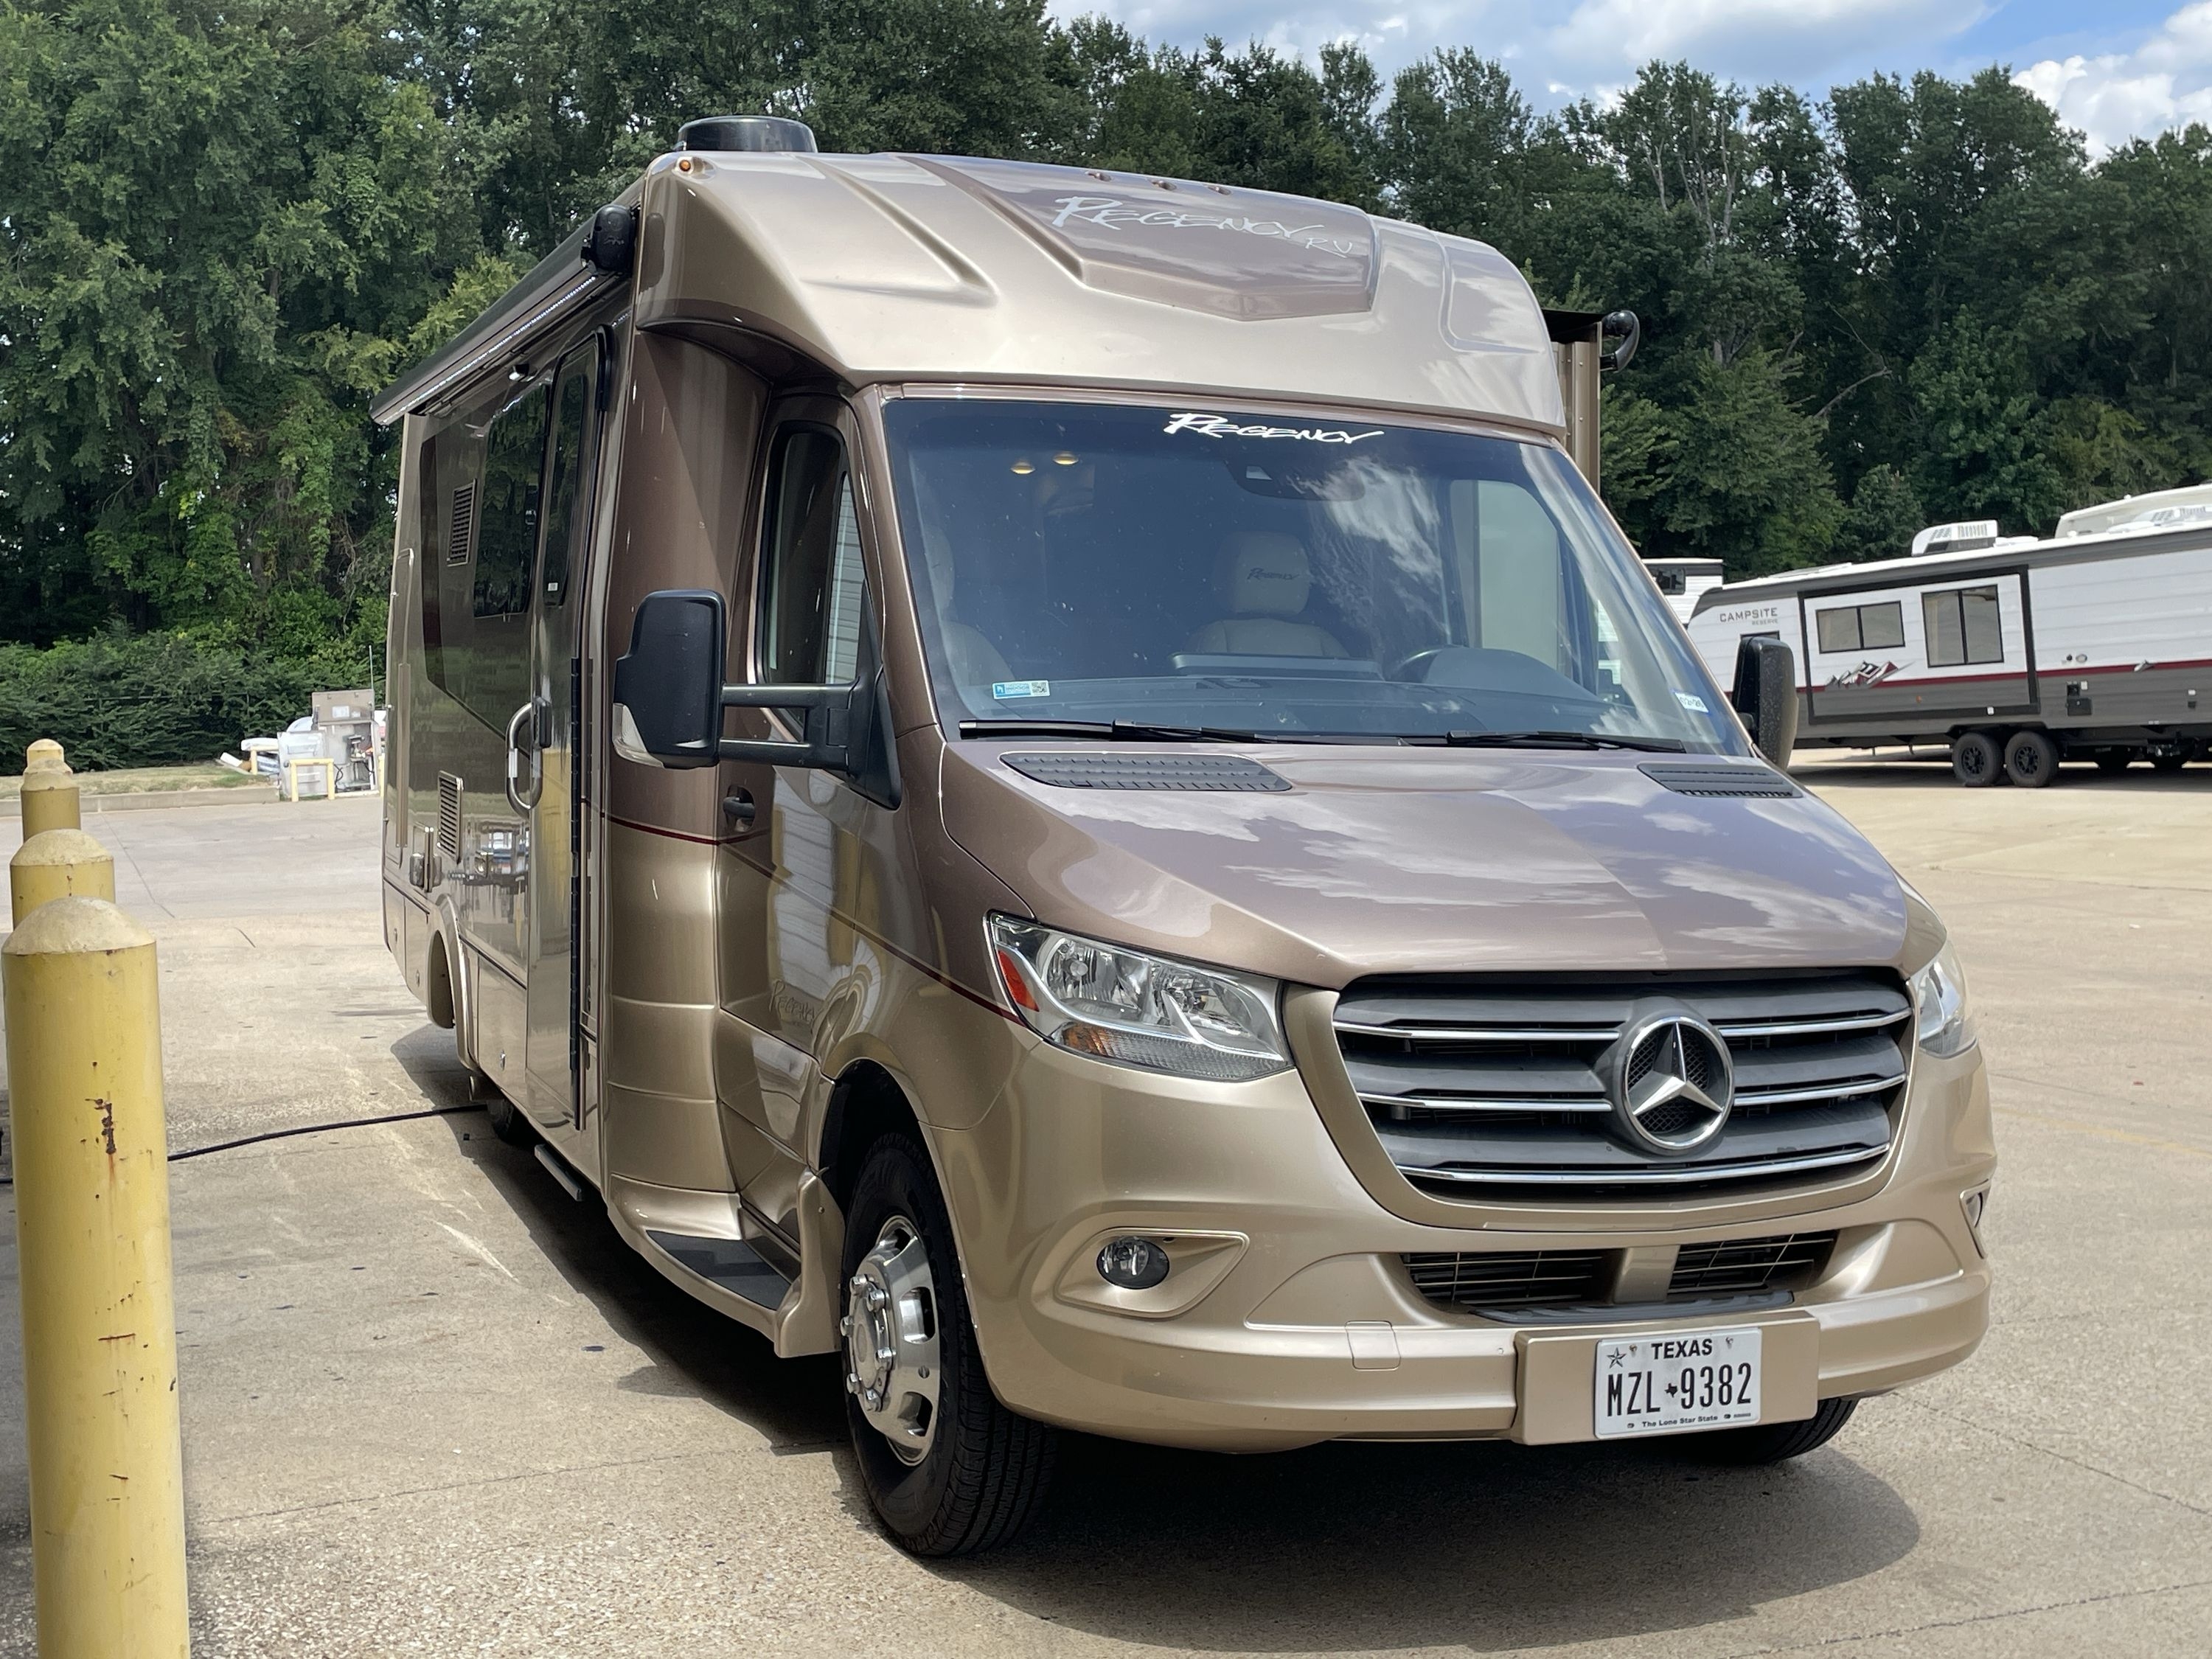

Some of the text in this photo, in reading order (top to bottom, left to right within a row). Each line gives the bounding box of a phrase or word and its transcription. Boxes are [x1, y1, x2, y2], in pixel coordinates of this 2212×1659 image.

[1304, 237, 1352, 258] RV
[1719, 607, 1778, 622] CAMPSITE
[1651, 1338, 1713, 1360] TEXAS
[1607, 1363, 1751, 1417] MZL 9382
